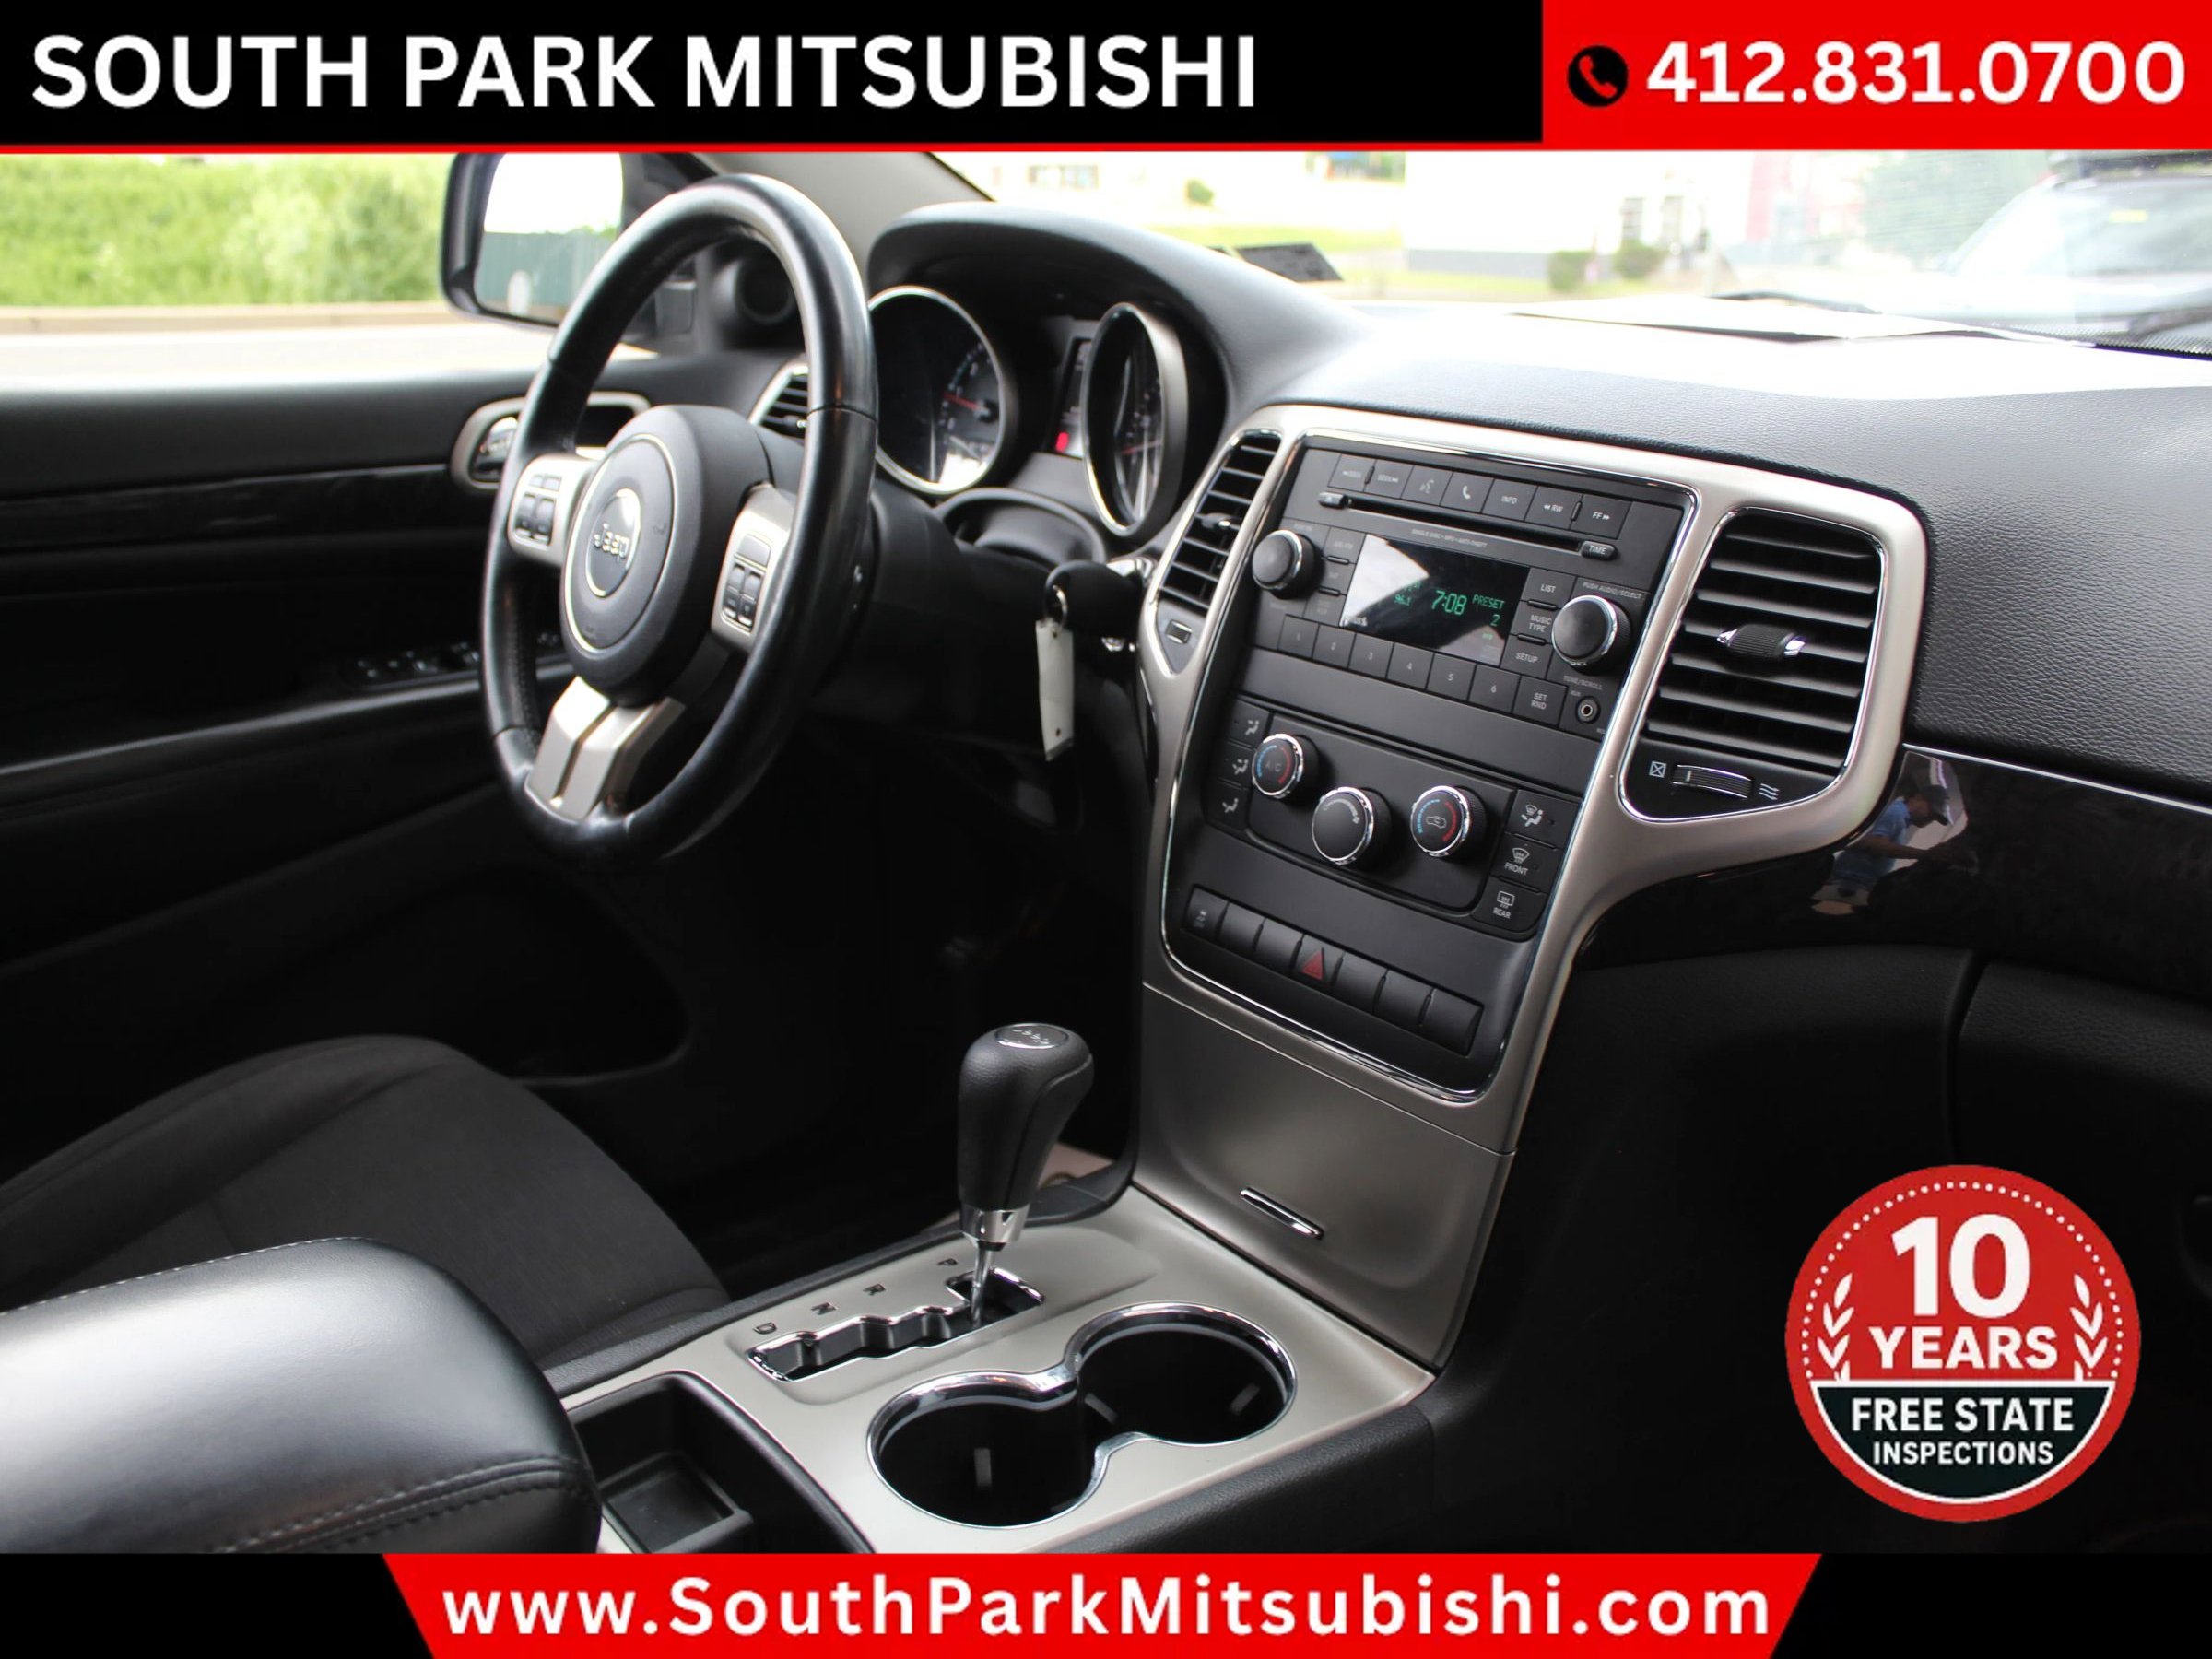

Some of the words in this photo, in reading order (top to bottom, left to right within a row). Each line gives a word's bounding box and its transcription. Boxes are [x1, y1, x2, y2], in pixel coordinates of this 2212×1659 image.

[1592, 512, 1603, 520] FF
[594, 523, 630, 562] Jeep
[1588, 545, 1607, 555] TIME
[1540, 583, 1557, 594] LIST
[1582, 582, 1599, 592] PUSH
[1430, 589, 1467, 616] 7:08
[1472, 593, 1505, 610] PRESET
[1489, 613, 1501, 627] 2
[1530, 614, 1552, 626] MUSIC
[1528, 623, 1547, 633] TYPE
[1515, 652, 1539, 664] SETUP
[1406, 661, 1413, 670] 4
[1447, 673, 1453, 682] 5
[1490, 685, 1497, 693] 6
[1533, 692, 1548, 702] SET
[1530, 700, 1547, 711] RND
[1504, 862, 1529, 876] FRONT
[1493, 906, 1512, 919] REAR
[936, 1257, 959, 1266] P
[753, 1322, 778, 1335] D
